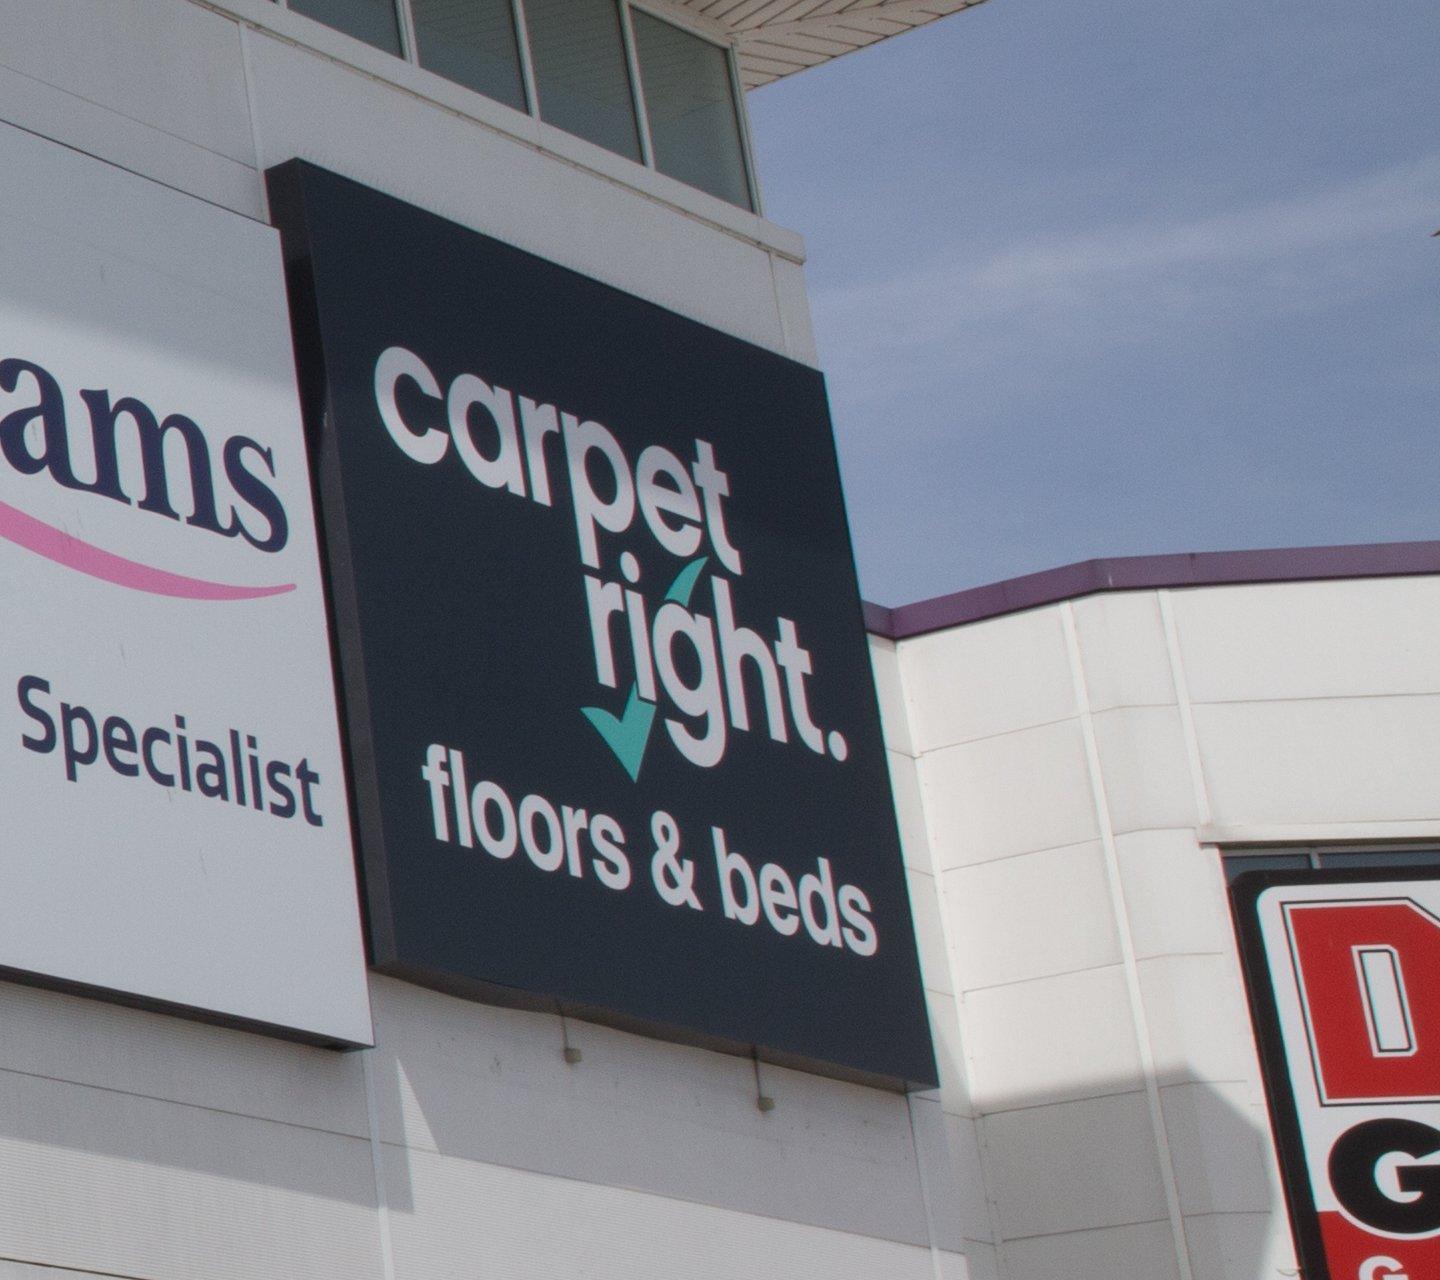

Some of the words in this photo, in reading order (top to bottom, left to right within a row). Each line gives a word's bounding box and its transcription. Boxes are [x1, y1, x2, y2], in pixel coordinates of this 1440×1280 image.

[374, 346, 742, 576] carpet
[17, 673, 323, 827] Specialist
[422, 744, 631, 890] floors
[650, 811, 703, 911] &
[711, 826, 878, 956] beds
